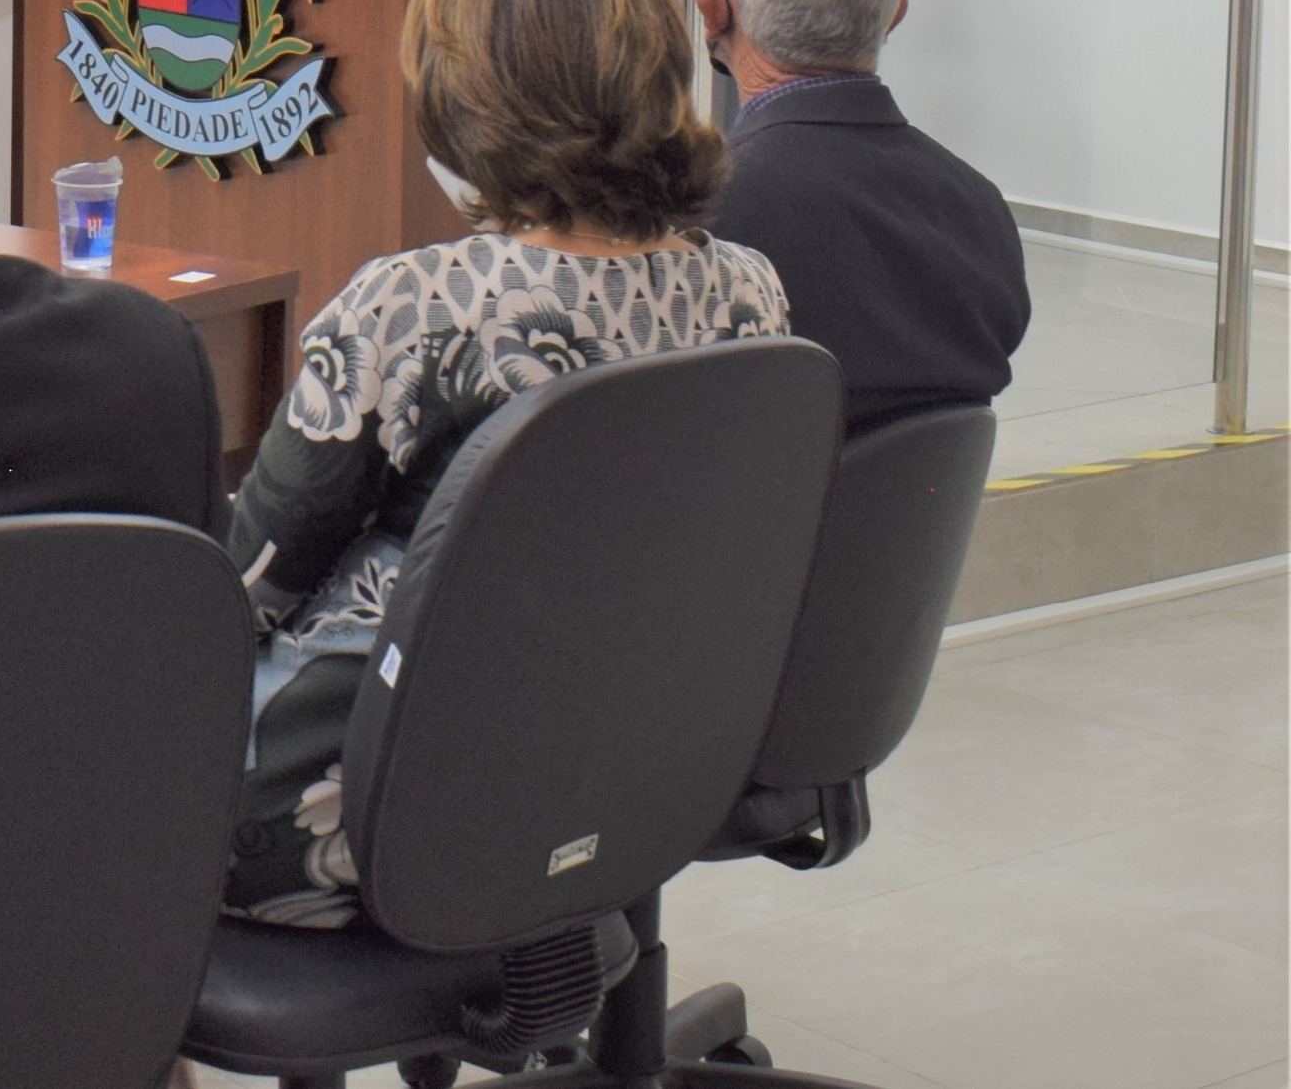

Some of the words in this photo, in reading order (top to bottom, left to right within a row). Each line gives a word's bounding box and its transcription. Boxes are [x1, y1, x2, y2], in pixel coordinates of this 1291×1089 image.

[67, 39, 119, 109] 1840
[130, 86, 249, 143] PIEDADE
[258, 82, 320, 145] 1892
